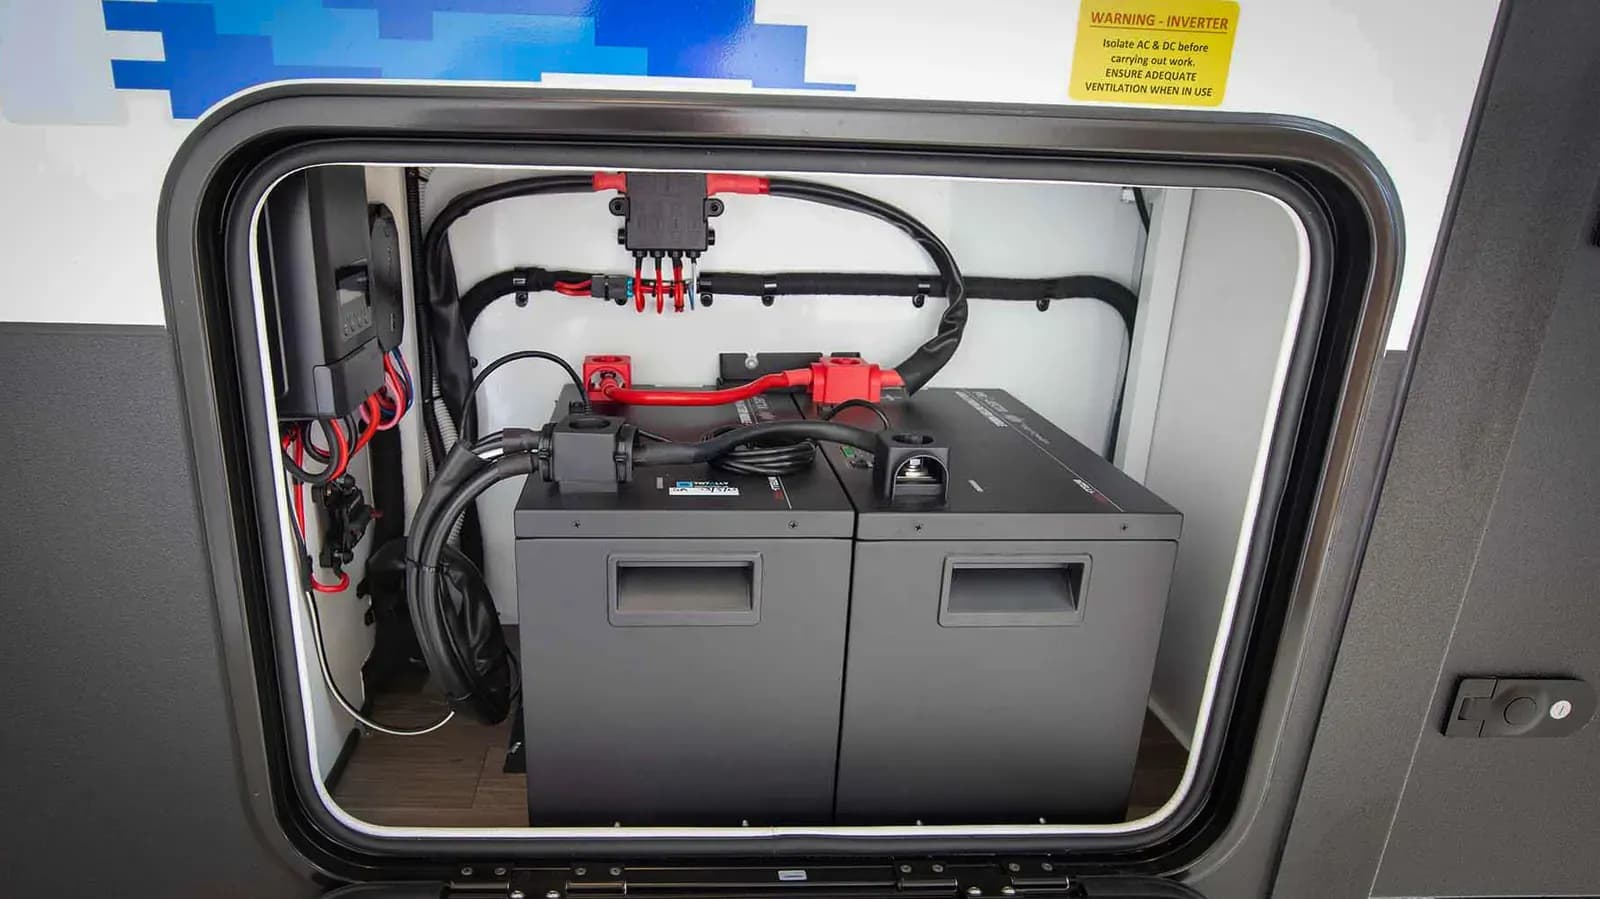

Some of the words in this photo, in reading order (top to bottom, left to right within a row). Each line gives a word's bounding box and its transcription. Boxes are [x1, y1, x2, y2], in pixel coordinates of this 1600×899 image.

[1090, 11, 1155, 26] WARNING
[1166, 15, 1229, 30] INVERTER
[1103, 38, 1134, 49] Isolate
[1136, 40, 1150, 50] AC
[1152, 40, 1160, 50] &
[1162, 41, 1176, 51] DC
[1178, 41, 1209, 52] before
[1111, 54, 1148, 66] carrying
[1151, 56, 1166, 66] out
[1169, 56, 1195, 67] work.
[1105, 68, 1143, 79] ENSURE
[1145, 70, 1197, 82] ADEQUATE
[1085, 82, 1148, 94] VENTILATION
[1150, 85, 1179, 95] WHEN
[1182, 86, 1192, 96] IN
[1194, 87, 1213, 97] USE
